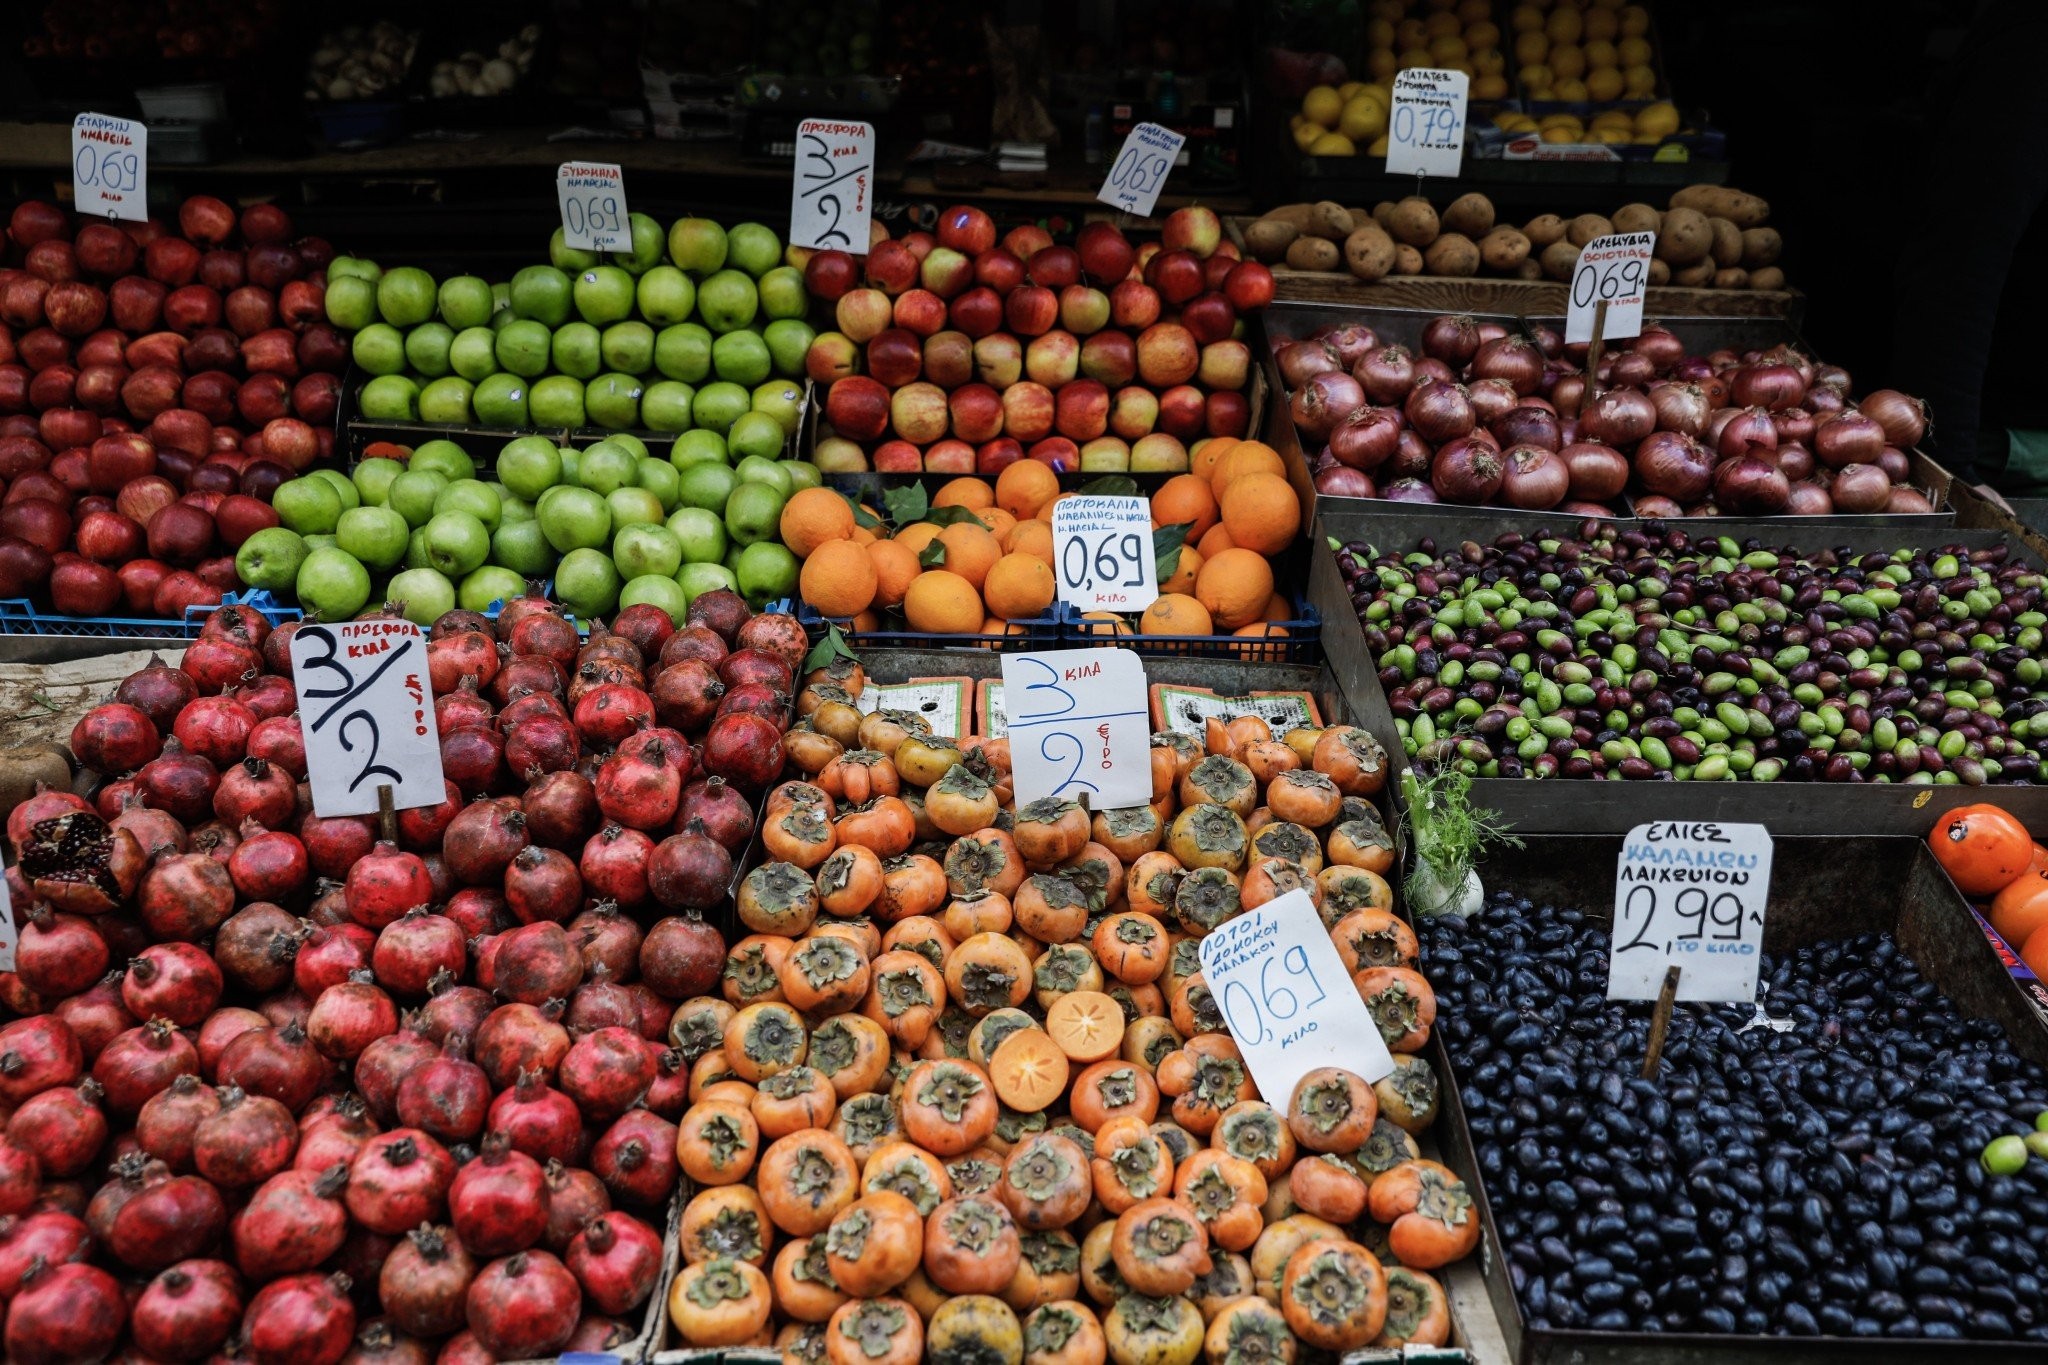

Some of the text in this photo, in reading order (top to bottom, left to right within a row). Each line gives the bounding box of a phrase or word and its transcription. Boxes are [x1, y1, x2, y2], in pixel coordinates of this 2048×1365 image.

[1403, 71, 1451, 82] ΠΑΤΑΤΕΣ
[800, 122, 866, 138] ΠΡΟΣΦΟΡΑ
[1394, 106, 1455, 148] 0,79
[76, 145, 137, 191] 0,69
[802, 134, 836, 179] 3
[833, 146, 858, 158] ΚΙΛΑ
[1112, 148, 1167, 193] 0,69
[101, 192, 122, 202] ΚΙΛΟ
[567, 197, 620, 238] 0,69
[814, 194, 851, 246] 2
[593, 236, 616, 244] ΚΙΛΟ
[1057, 499, 1140, 511] ΠΟΡΤΟΚΑΛΙΑ
[1063, 533, 1144, 591] 0,69
[1096, 593, 1127, 603] ΚΙΛΟ
[342, 623, 421, 638] ΠΡΟΣΦΟΡΑ
[348, 638, 391, 658] ΚΙΛΑ
[295, 626, 354, 698] 3
[1065, 661, 1101, 681] ΚΙΛΑ
[1016, 657, 1076, 718] 3
[339, 709, 403, 793] 2
[1041, 732, 1100, 796] 2
[1646, 823, 1731, 843] ΕΛΙΕΣ
[1625, 844, 1757, 870] ΚΑΛΑΜΩΝ
[1203, 912, 1262, 960] ΛΟΤΟΙ
[1212, 920, 1278, 967] ΔΟΜΟΚΟΥ
[1675, 941, 1755, 955] ΤΟ ΚΙΛΟ
[1212, 941, 1275, 980] ΜΑΛΑΚΟΙ
[1224, 945, 1326, 1046] 0,69
[1282, 1021, 1318, 1049] ΚΙΛΟ
